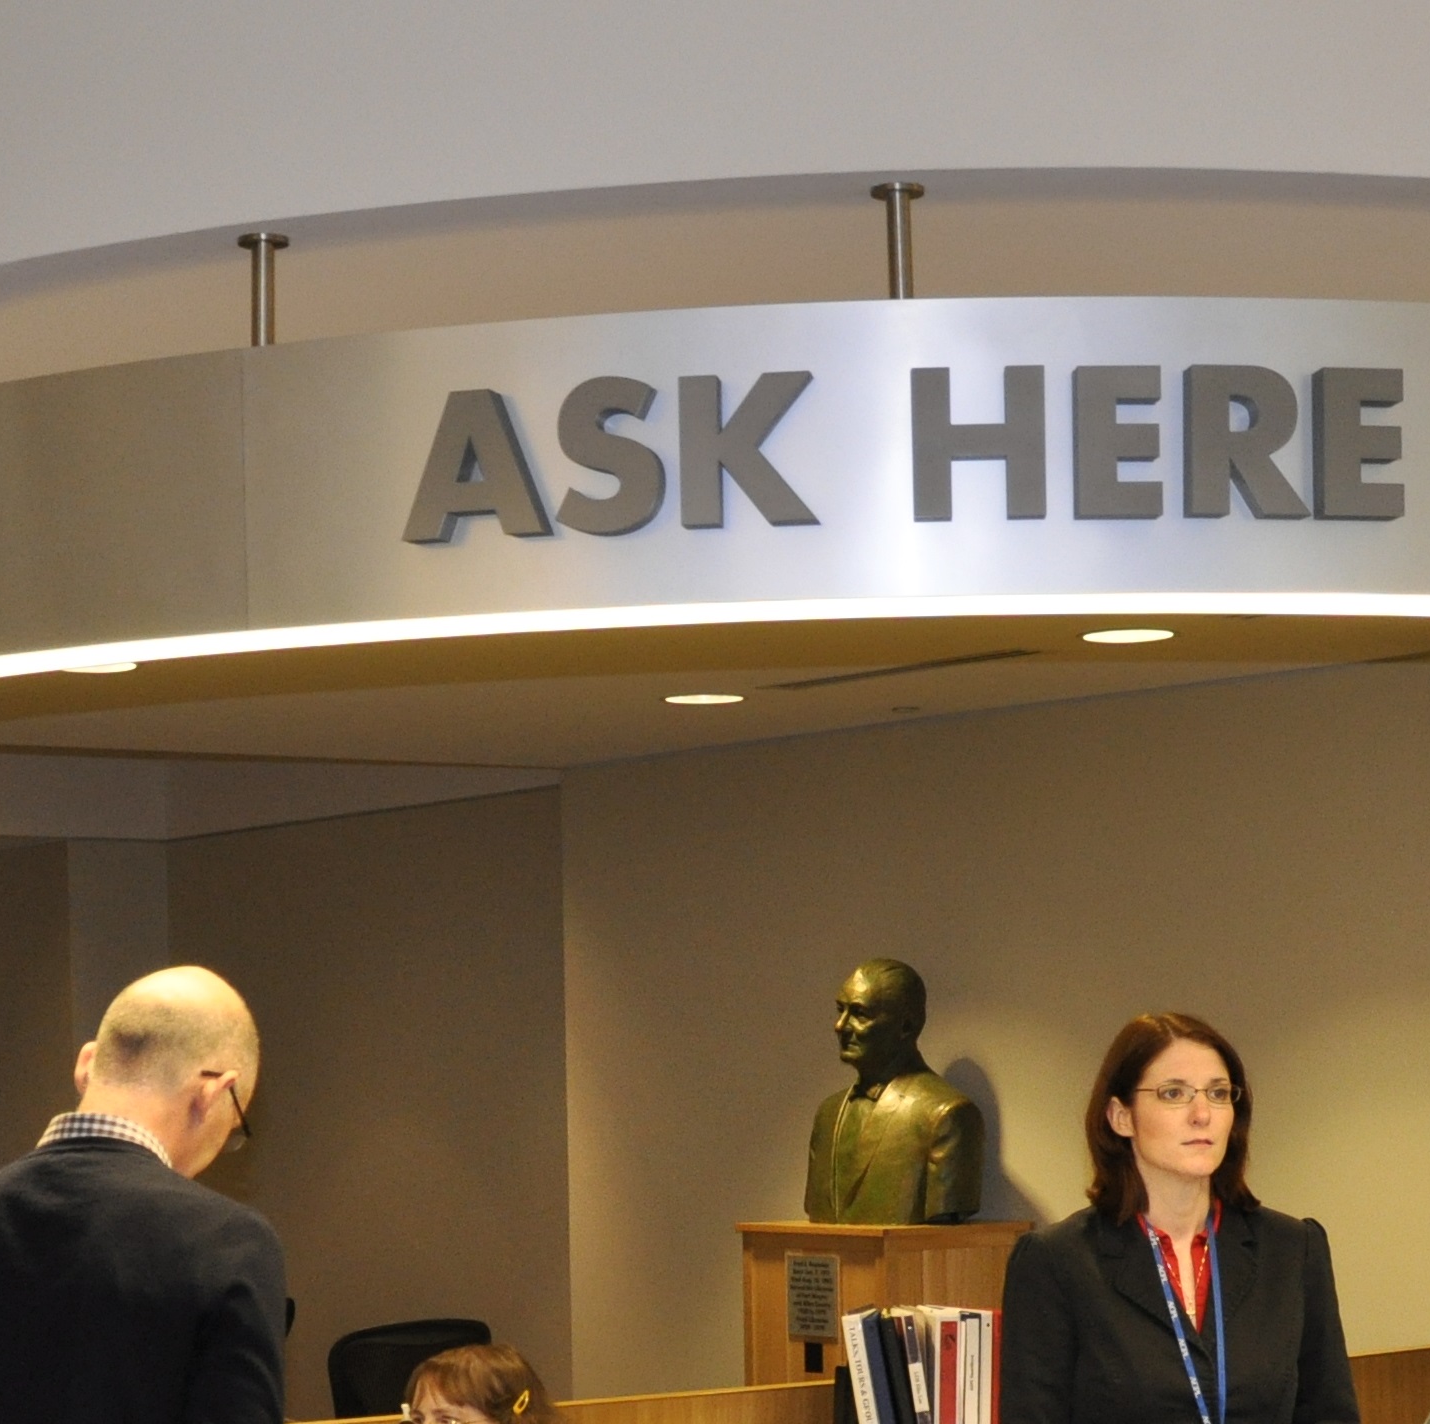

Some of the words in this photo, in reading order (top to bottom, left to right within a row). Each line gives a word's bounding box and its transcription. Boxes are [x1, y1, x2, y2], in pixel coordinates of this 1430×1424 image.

[403, 370, 821, 543] ASK
[910, 364, 1405, 522] HERE
[1157, 1263, 1168, 1283] ACPL
[1167, 1300, 1178, 1319] ACPL
[1178, 1337, 1189, 1359] ACPL
[855, 1359, 866, 1388] TOURS
[860, 1389, 867, 1397] &
[1189, 1376, 1201, 1398] ACPL
